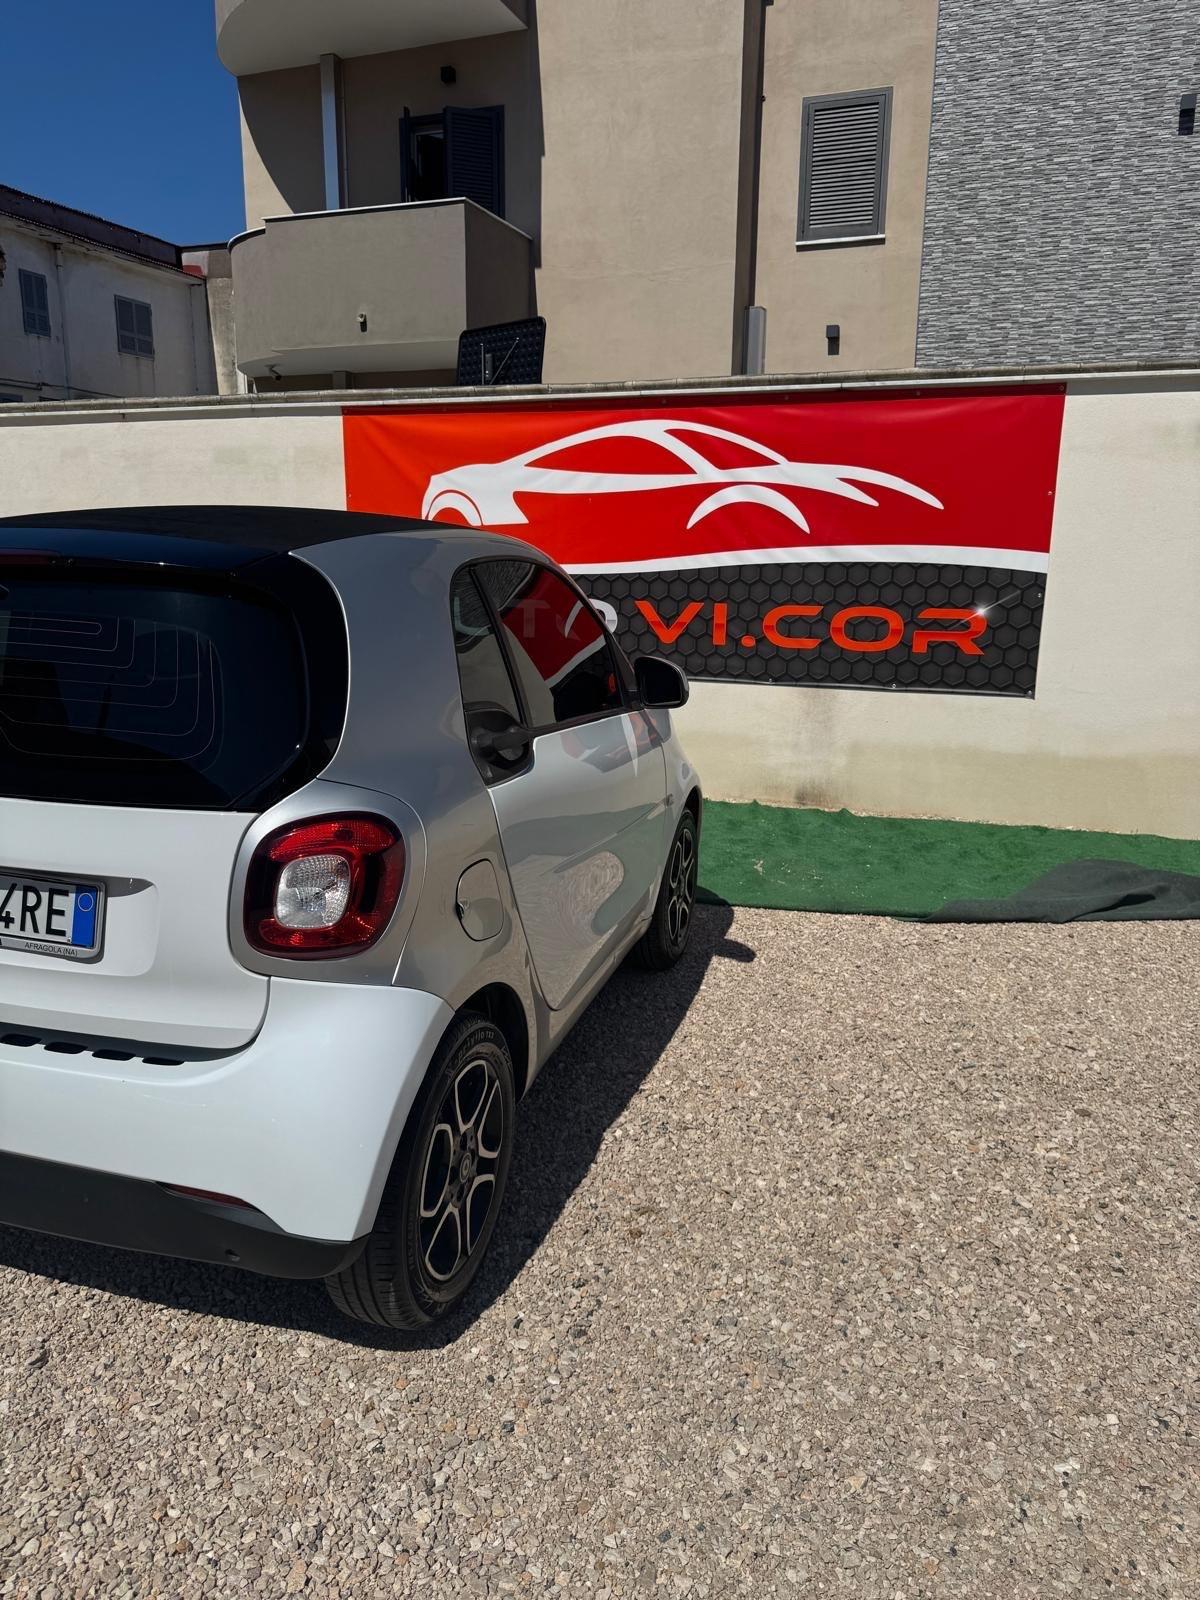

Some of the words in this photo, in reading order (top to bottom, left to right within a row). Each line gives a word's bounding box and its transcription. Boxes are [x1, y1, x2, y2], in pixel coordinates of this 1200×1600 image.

[634, 600, 987, 655] VI.COR
[25, 942, 62, 954] AFRAGOLA
[62, 947, 78, 957] (NA)
